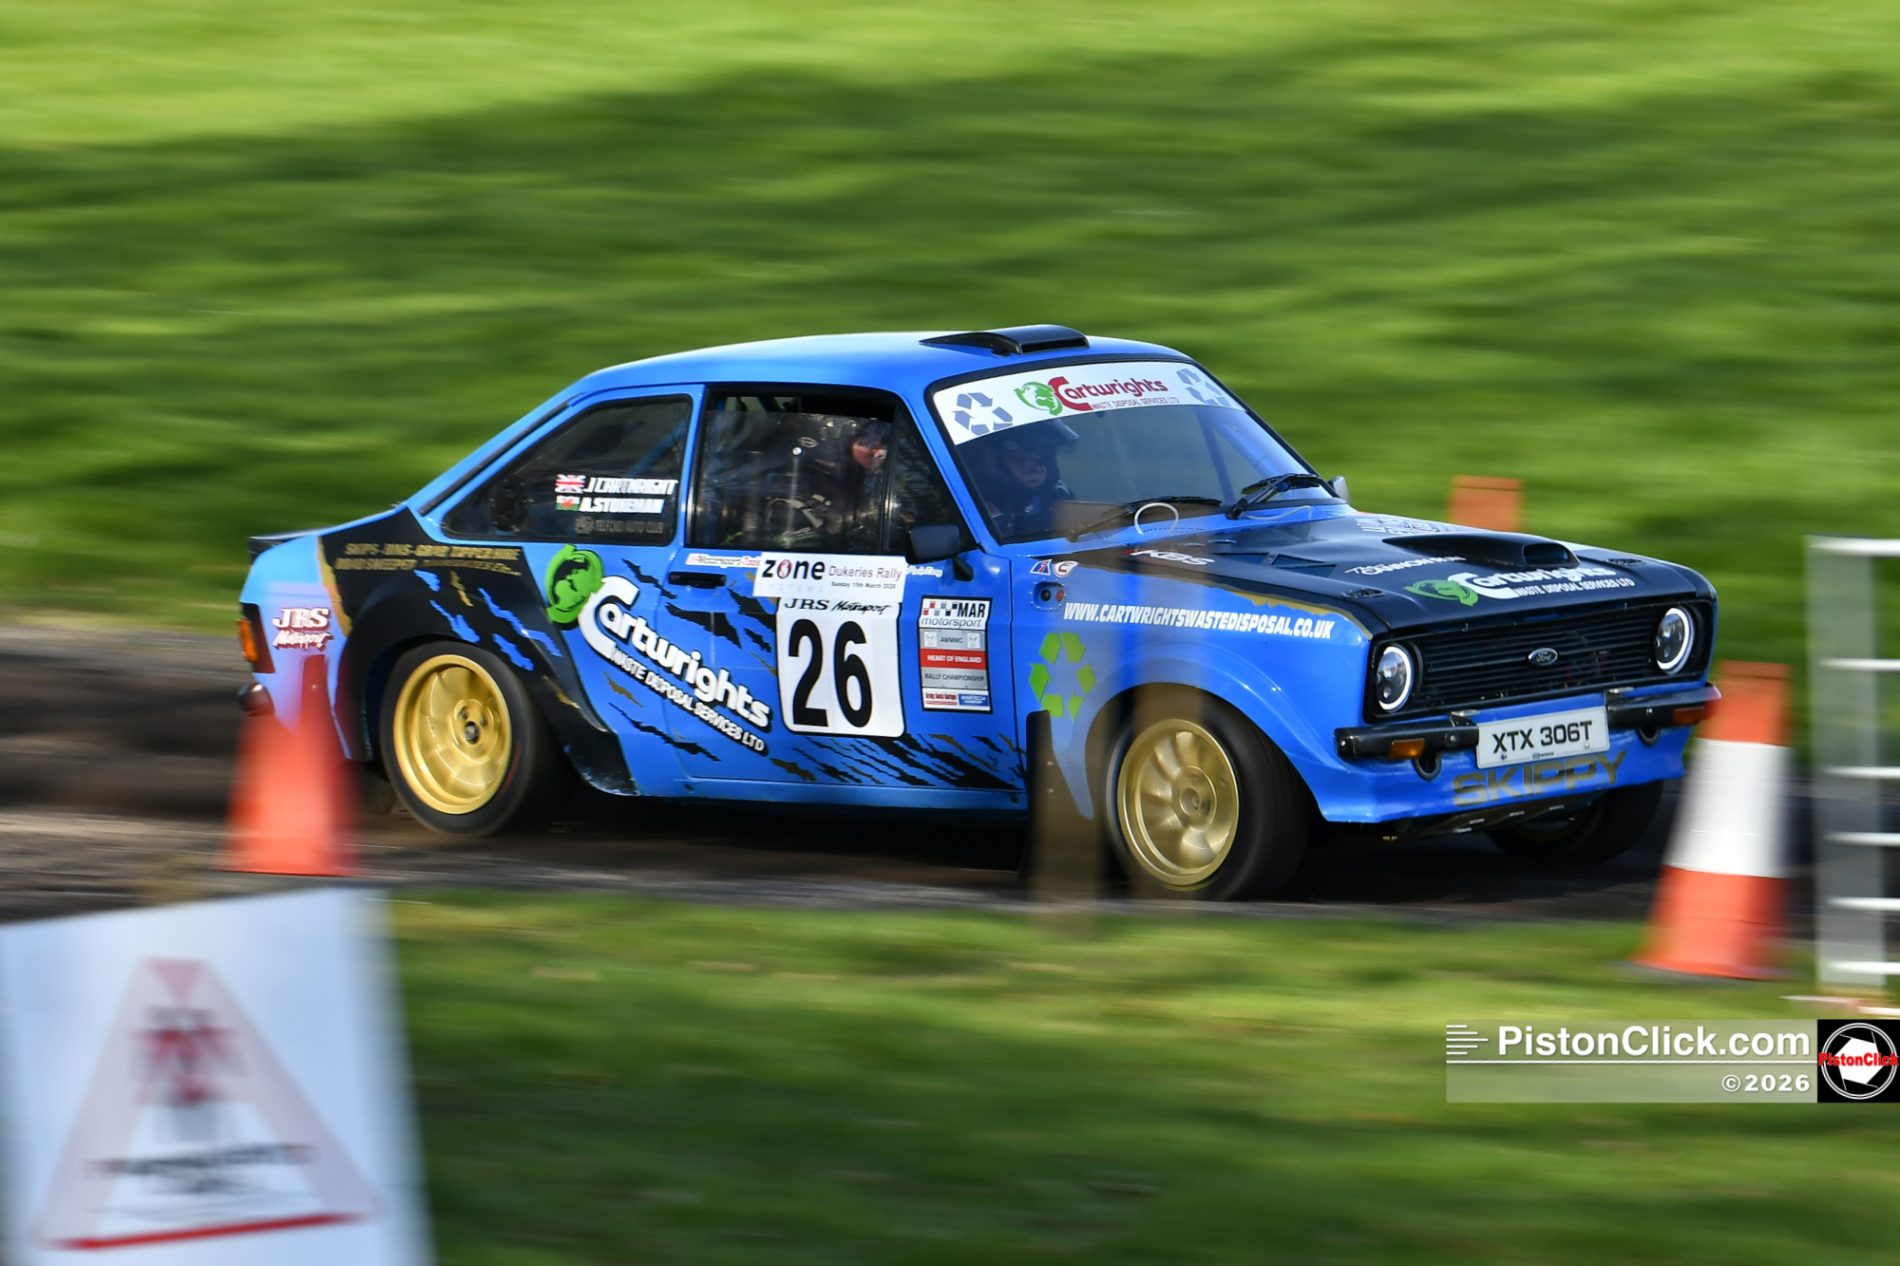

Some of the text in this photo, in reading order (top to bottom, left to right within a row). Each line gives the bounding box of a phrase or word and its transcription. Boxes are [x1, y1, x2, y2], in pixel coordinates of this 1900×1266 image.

[1048, 376, 1168, 411] Cartwrights
[1112, 400, 1139, 408] DISPOSAL
[762, 559, 825, 581] zone
[828, 565, 873, 578] Dukeries
[876, 567, 903, 582] Rally
[1448, 568, 1617, 600] Cartwrights
[1515, 577, 1636, 598] WASTE DISPOSAL SERVICES LTD
[785, 598, 830, 610] JRS
[957, 602, 986, 618] MAR
[272, 608, 331, 630] JRS
[921, 618, 982, 628] motorsport
[1063, 602, 1335, 639] WWW.CARTWRIGHTSWASTEDISPOSAL.CO.UK
[578, 575, 771, 729] Cartwrights
[927, 654, 946, 662] HEART
[954, 656, 982, 664] ENGLAND
[788, 618, 873, 728] 26
[612, 650, 765, 751] WASTE DISPOSAL SERVICES LTD
[1492, 720, 1593, 754] XTX 306T
[1453, 751, 1628, 807] SKIPPY
